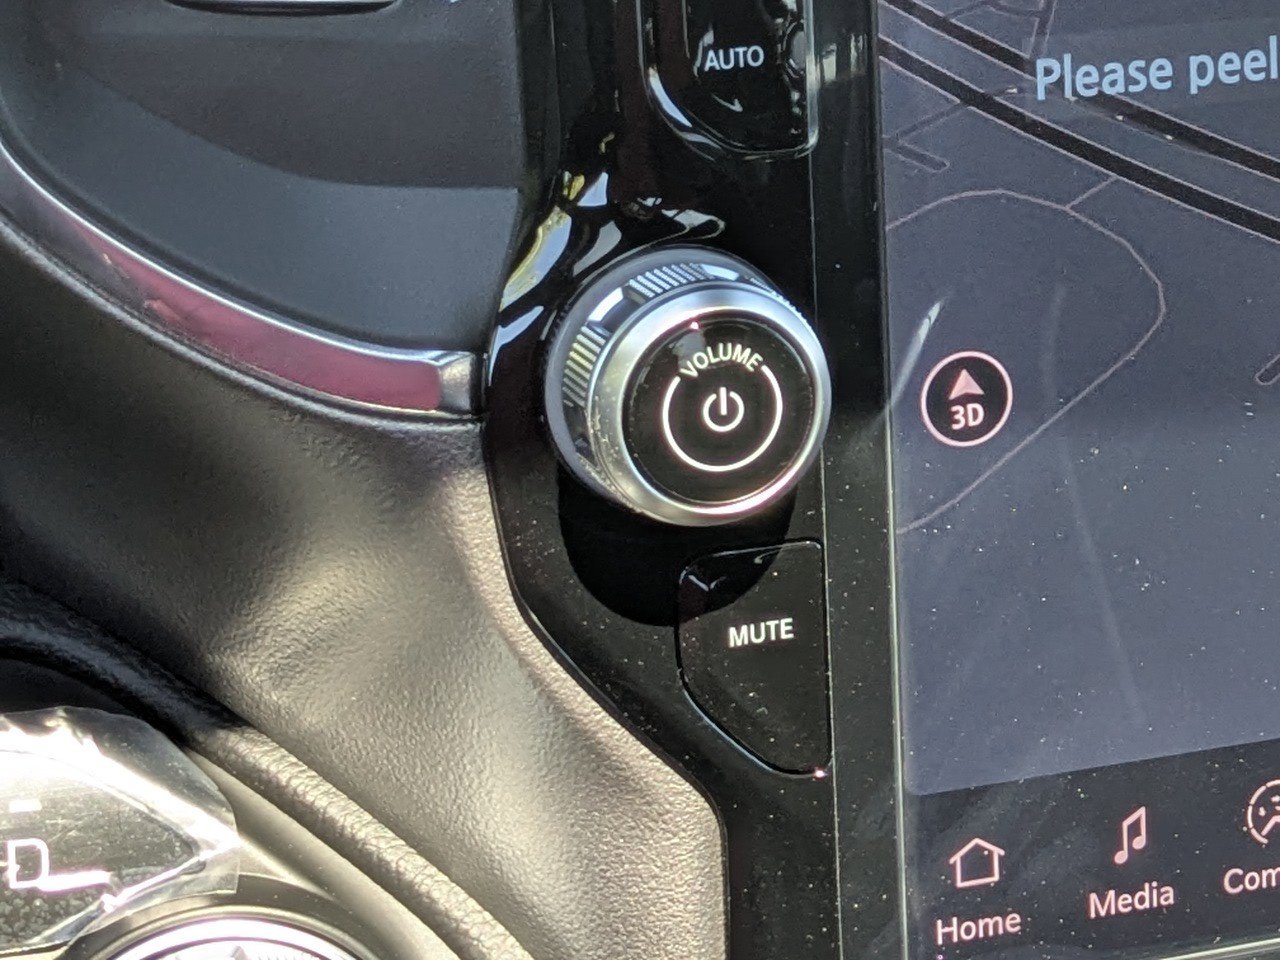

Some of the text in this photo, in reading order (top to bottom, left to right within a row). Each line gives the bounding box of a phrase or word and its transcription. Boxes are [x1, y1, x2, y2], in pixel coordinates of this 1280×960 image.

[704, 47, 765, 70] AUTO
[1036, 53, 1172, 100] Please
[1190, 35, 1278, 94] peel
[679, 343, 763, 379] VOLUME
[950, 403, 984, 430] 3D
[729, 617, 794, 648] MUTE
[1089, 882, 1175, 919] Media
[936, 911, 1021, 945] Home
